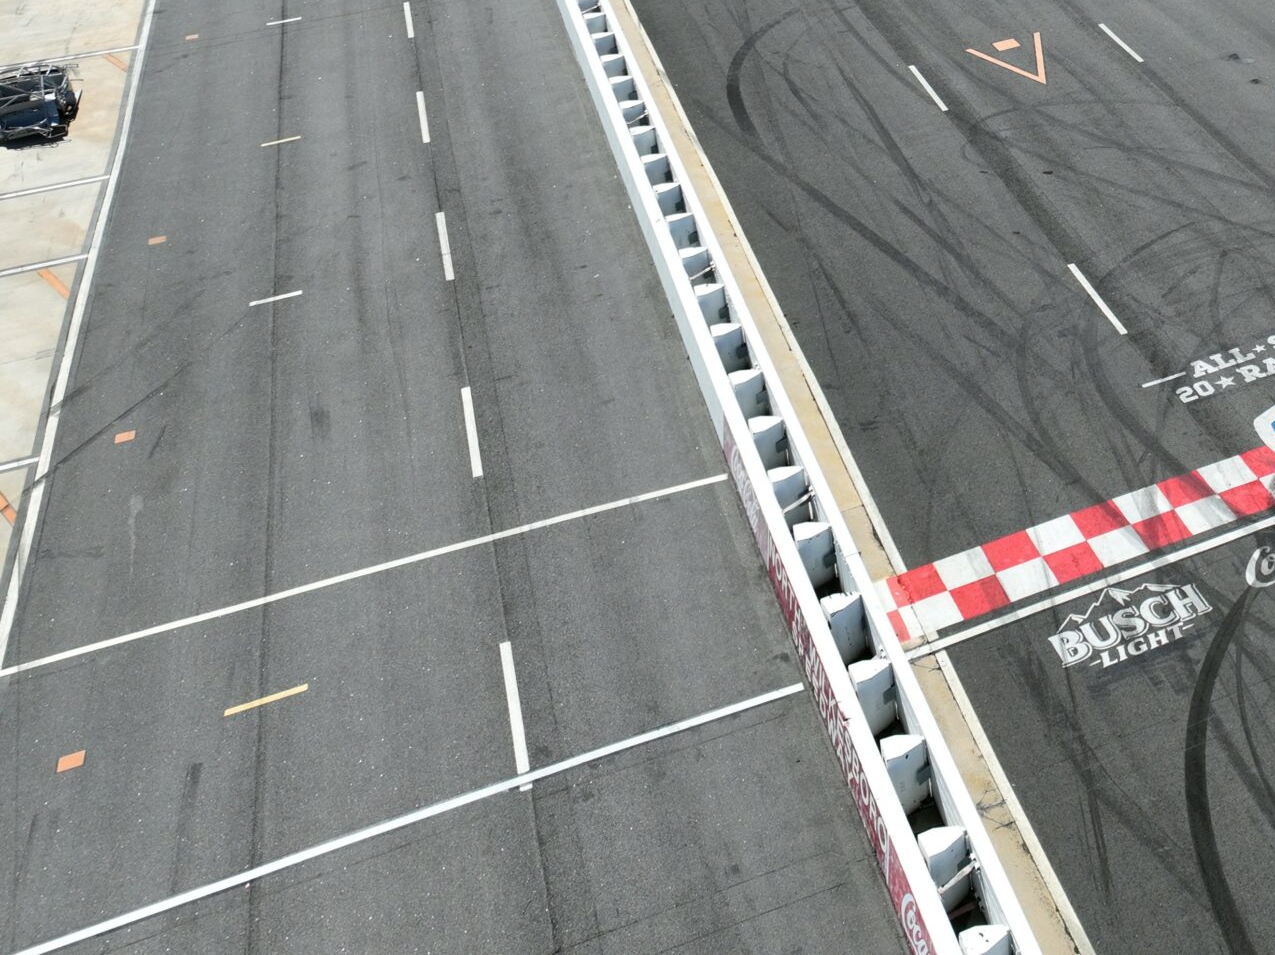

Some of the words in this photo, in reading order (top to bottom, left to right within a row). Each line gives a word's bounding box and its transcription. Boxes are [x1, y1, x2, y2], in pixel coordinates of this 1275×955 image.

[1176, 380, 1215, 404] 20
[768, 534, 801, 629] NORTH
[1048, 583, 1213, 668] BUSCH
[1101, 622, 1184, 669] LIGHT
